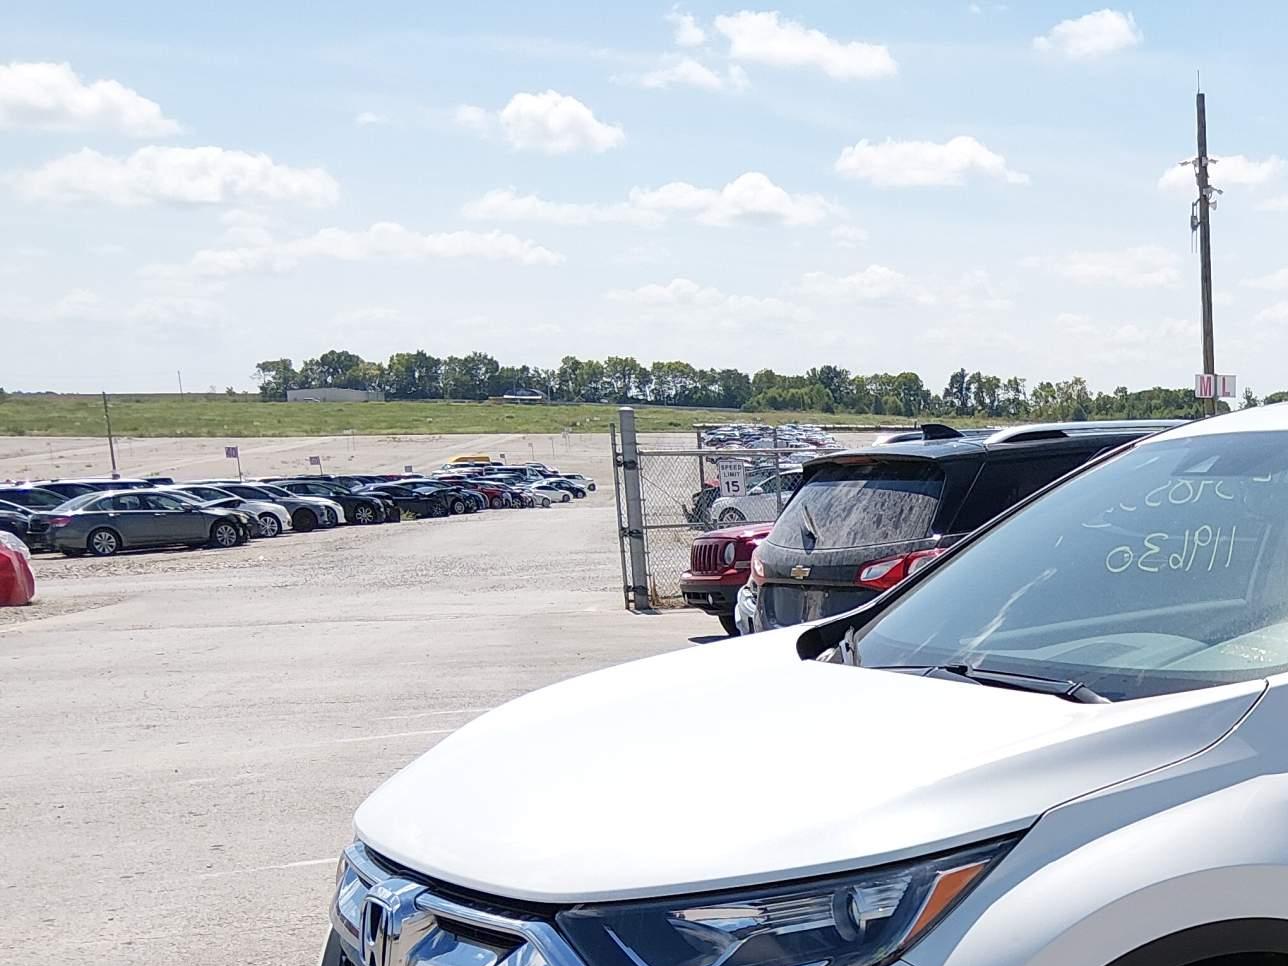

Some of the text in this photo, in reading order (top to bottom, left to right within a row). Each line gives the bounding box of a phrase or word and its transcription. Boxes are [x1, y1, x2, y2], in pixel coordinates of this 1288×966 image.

[1200, 376, 1212, 397] M
[1222, 376, 1231, 397] L
[725, 480, 740, 493] 15
